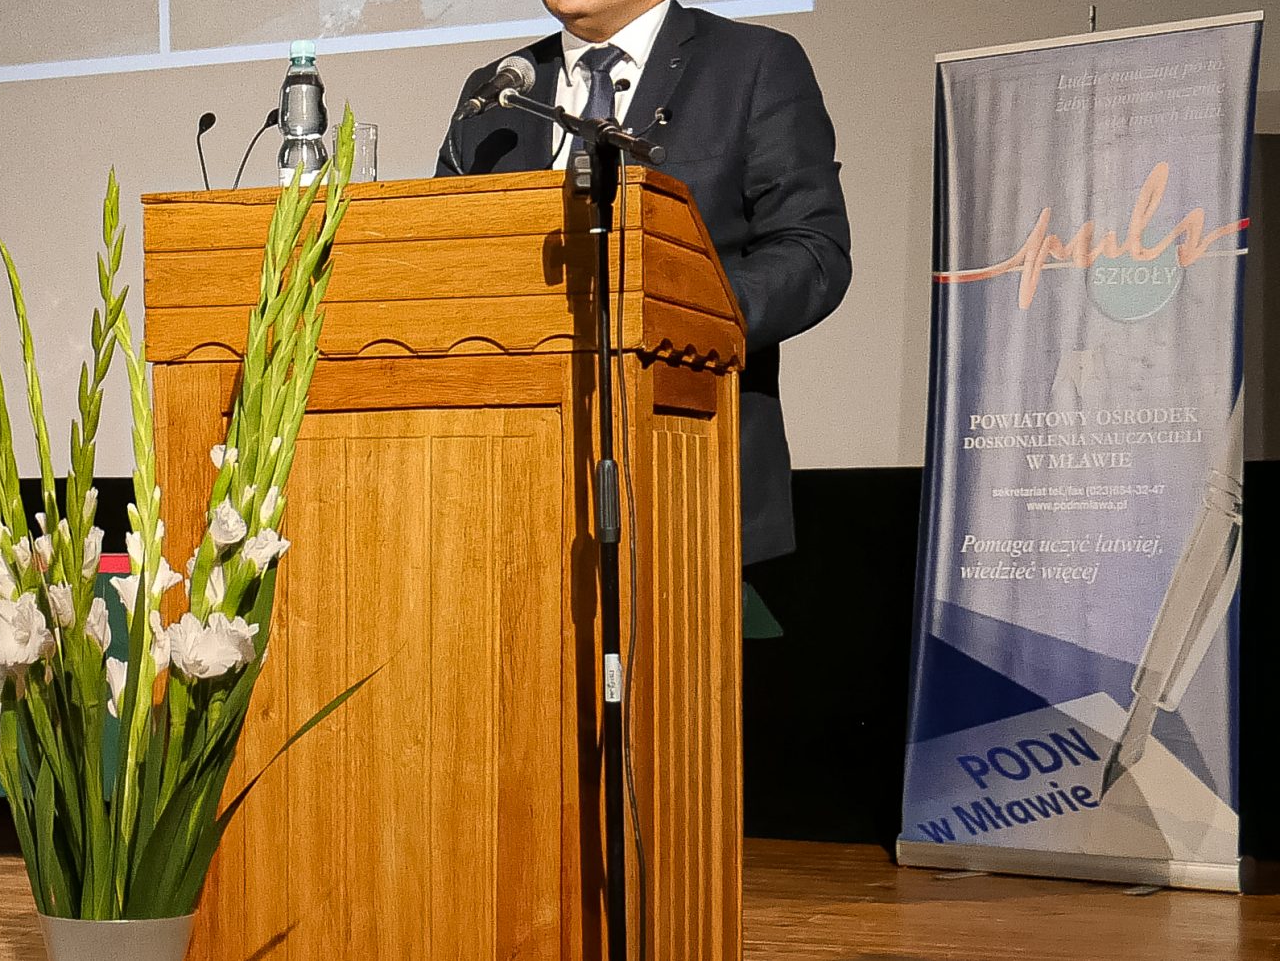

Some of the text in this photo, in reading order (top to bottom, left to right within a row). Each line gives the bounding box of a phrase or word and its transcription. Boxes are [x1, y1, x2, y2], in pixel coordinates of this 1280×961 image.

[1002, 162, 1228, 309] puls
[1093, 266, 1177, 286] SZKOŁY
[969, 411, 1091, 430] POWIATOWY
[963, 430, 1203, 450] DOSKONALENIA NAUCZYCIELI
[1026, 452, 1134, 470] W MŁAWIE
[992, 485, 1047, 498] sekretariat
[960, 535, 1034, 558] Pomaga
[1039, 535, 1091, 557] uczyć
[960, 560, 1101, 584] wiedzieć więcej
[956, 727, 1101, 790] PODN
[951, 781, 1102, 837] Mławie
